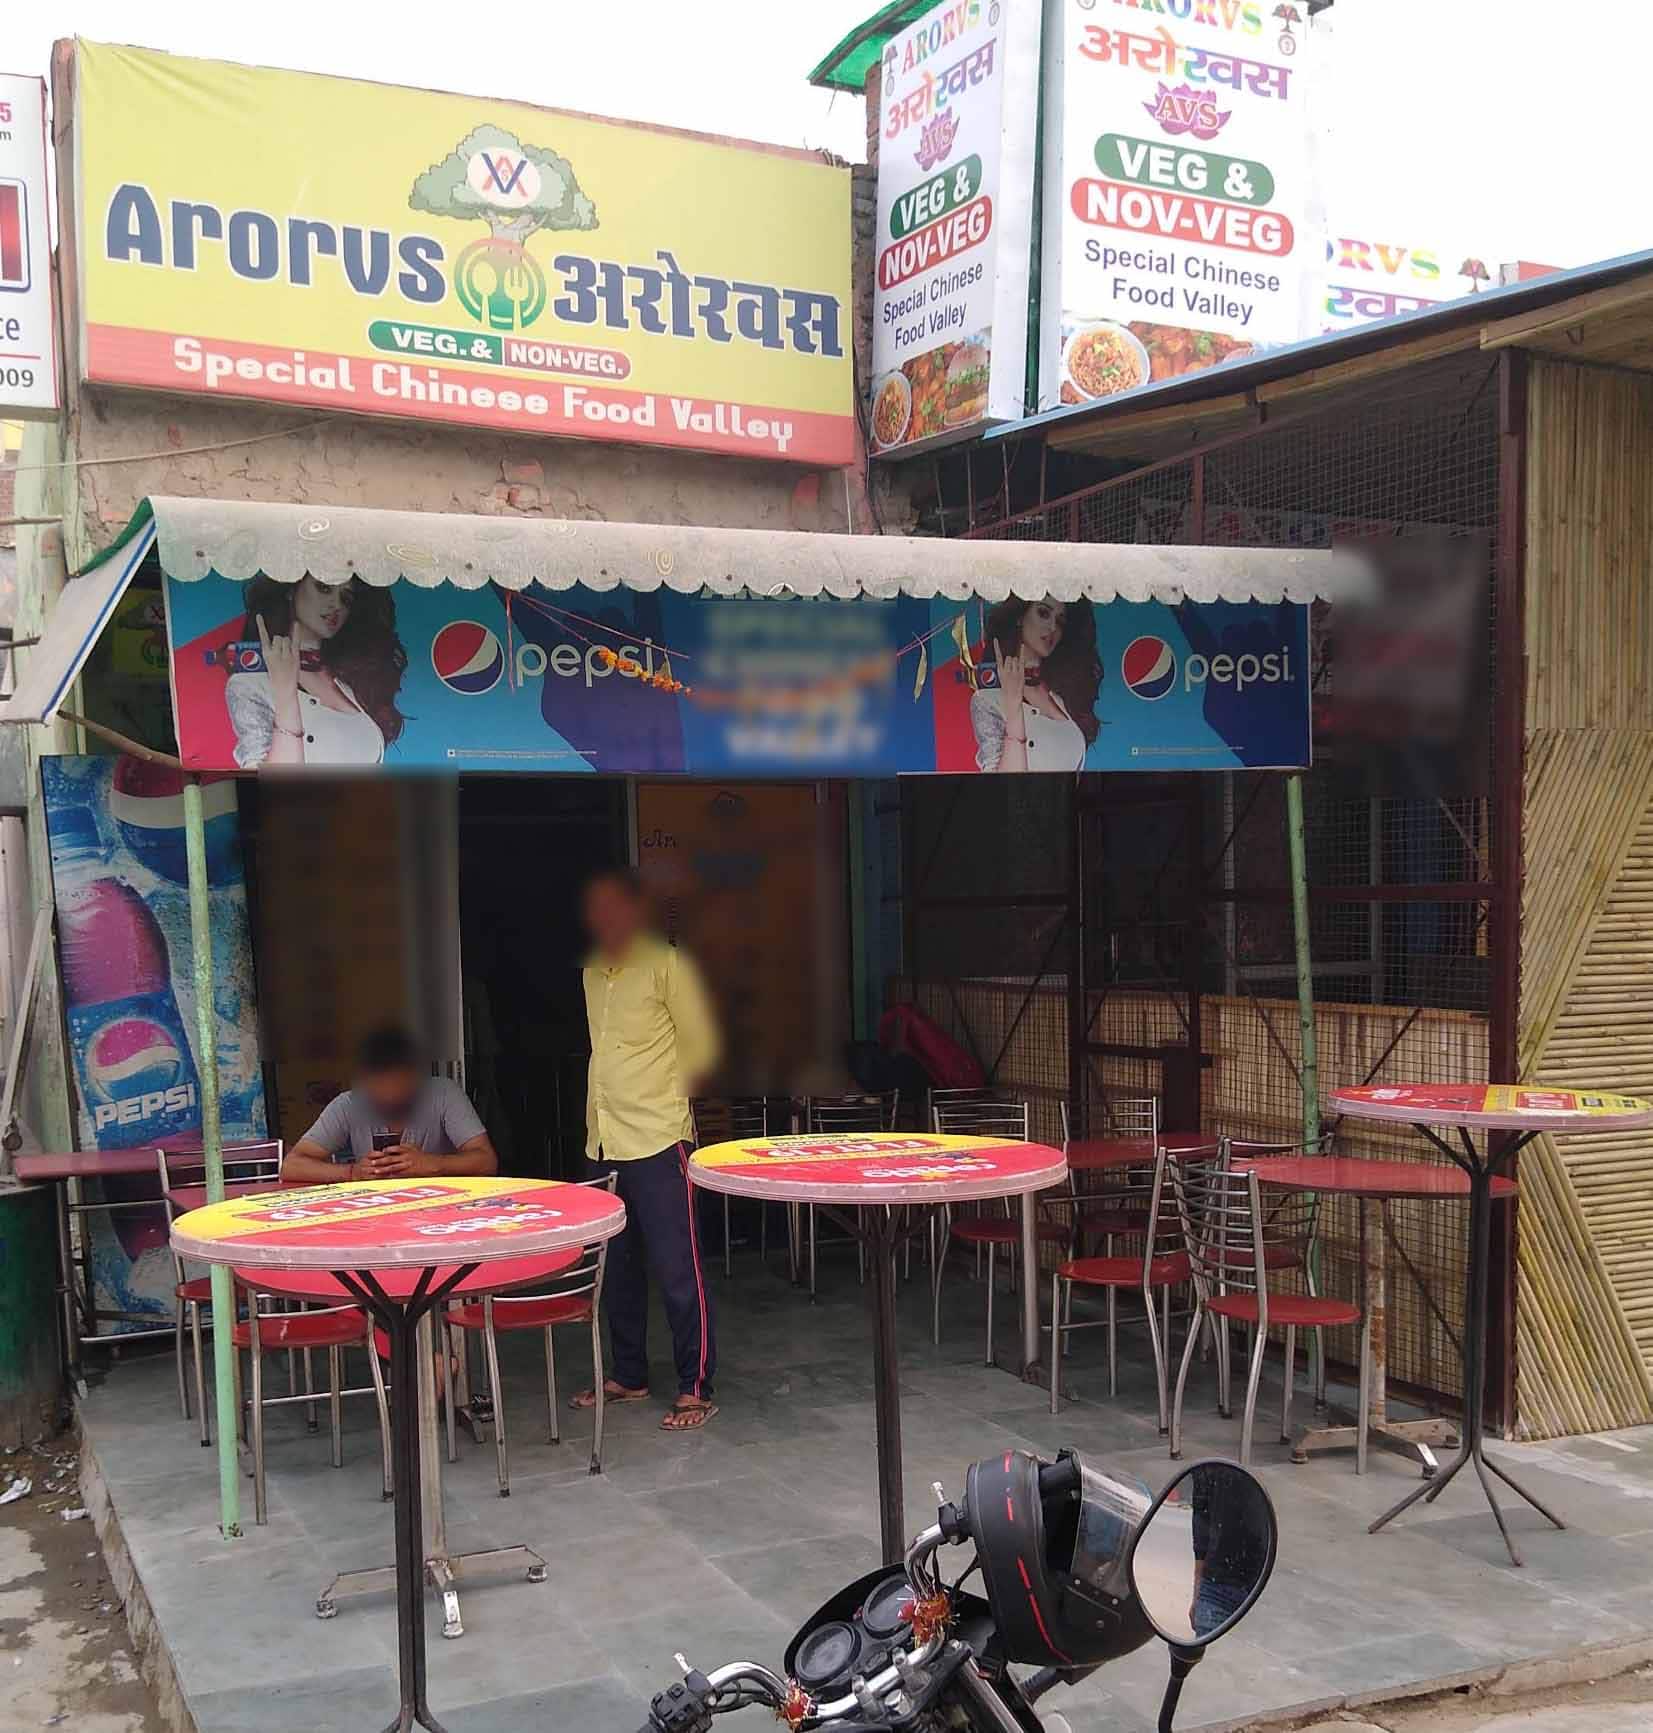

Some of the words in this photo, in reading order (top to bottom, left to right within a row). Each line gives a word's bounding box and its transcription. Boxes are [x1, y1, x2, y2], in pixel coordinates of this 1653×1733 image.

[902, 0, 981, 75] ARORVS
[1110, 0, 1263, 36] ORVS
[1155, 95, 1219, 128] AVS
[920, 120, 954, 158] AVS
[1116, 140, 1208, 190] VEG
[1223, 162, 1255, 200] &
[900, 179, 945, 231] VEG
[953, 165, 971, 202] &
[1086, 184, 1284, 251] NOV-VEG
[885, 203, 985, 284] NOV-VEG
[1085, 239, 1175, 275] Special
[1184, 256, 1280, 291] Chinese
[1326, 238, 1440, 279] RVS
[884, 283, 927, 326] Special
[930, 263, 983, 302] Chinese
[1112, 277, 1174, 308] Food
[1183, 288, 1253, 326] Valley
[895, 319, 926, 351] Food
[929, 303, 967, 336] Valley
[510, 342, 624, 376] NON-VEG.
[173, 336, 356, 393] Special
[372, 362, 549, 416] Chinese
[562, 386, 656, 427] Food
[671, 398, 793, 453] Valley
[515, 638, 660, 688] pepsi
[1184, 645, 1289, 692] pepsi
[95, 1083, 196, 1131] PEPSI
[341, 1187, 449, 1209] FLAT
